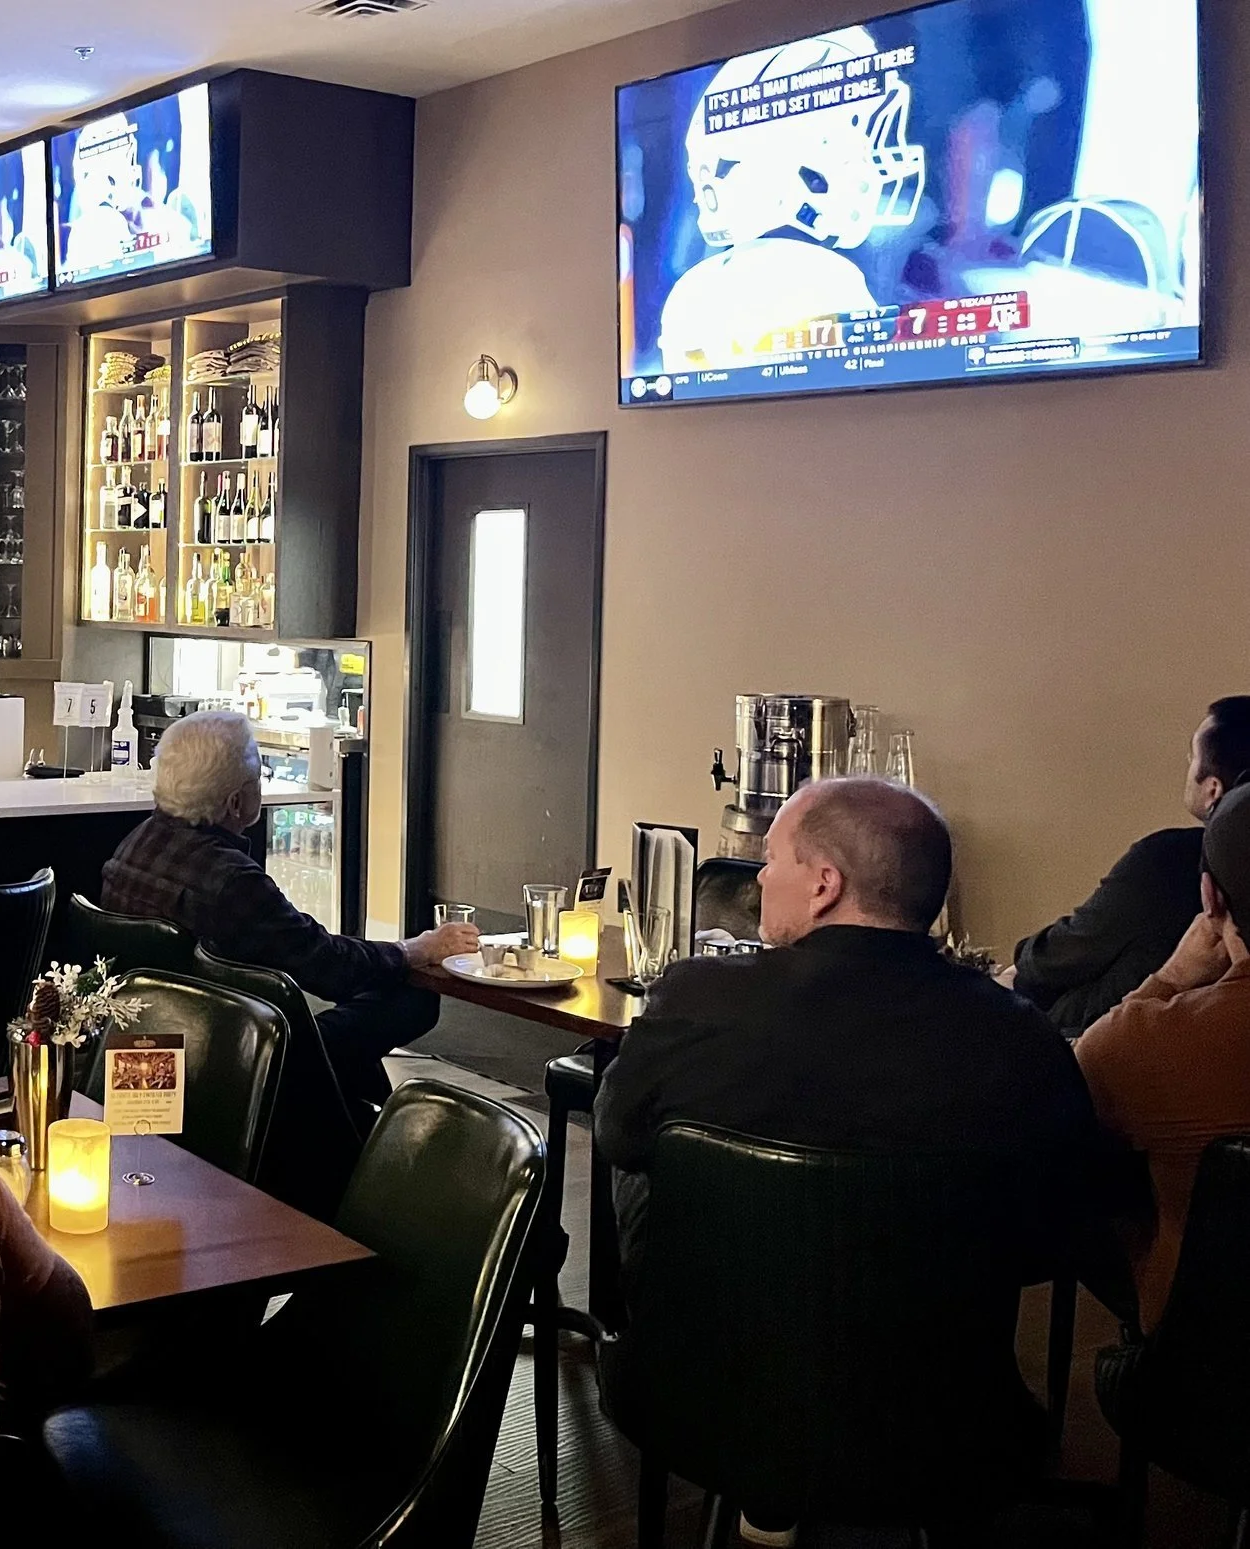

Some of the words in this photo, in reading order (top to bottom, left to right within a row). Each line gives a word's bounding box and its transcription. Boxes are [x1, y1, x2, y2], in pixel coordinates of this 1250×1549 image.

[708, 93, 729, 111] IT'S
[730, 91, 739, 106] A
[740, 84, 761, 104] BIG
[763, 79, 788, 98] MAN
[790, 65, 844, 92] RUNNING
[846, 57, 872, 78] OUT
[874, 46, 915, 71] THERE
[708, 114, 723, 131] TO
[724, 111, 740, 128] BE
[741, 105, 770, 124] ABLE
[772, 100, 787, 117] TO
[789, 94, 810, 113] SET
[813, 87, 842, 107] THAT
[844, 77, 880, 101] EDGE.
[959, 295, 993, 308] TEXAS
[809, 319, 833, 345] 17
[908, 308, 927, 335] 7
[853, 337, 947, 355] CHAMPIONSHIP
[950, 334, 987, 347] GAME
[700, 372, 728, 383] UConn
[67, 698, 73, 713] 7
[90, 698, 96, 715] 5
